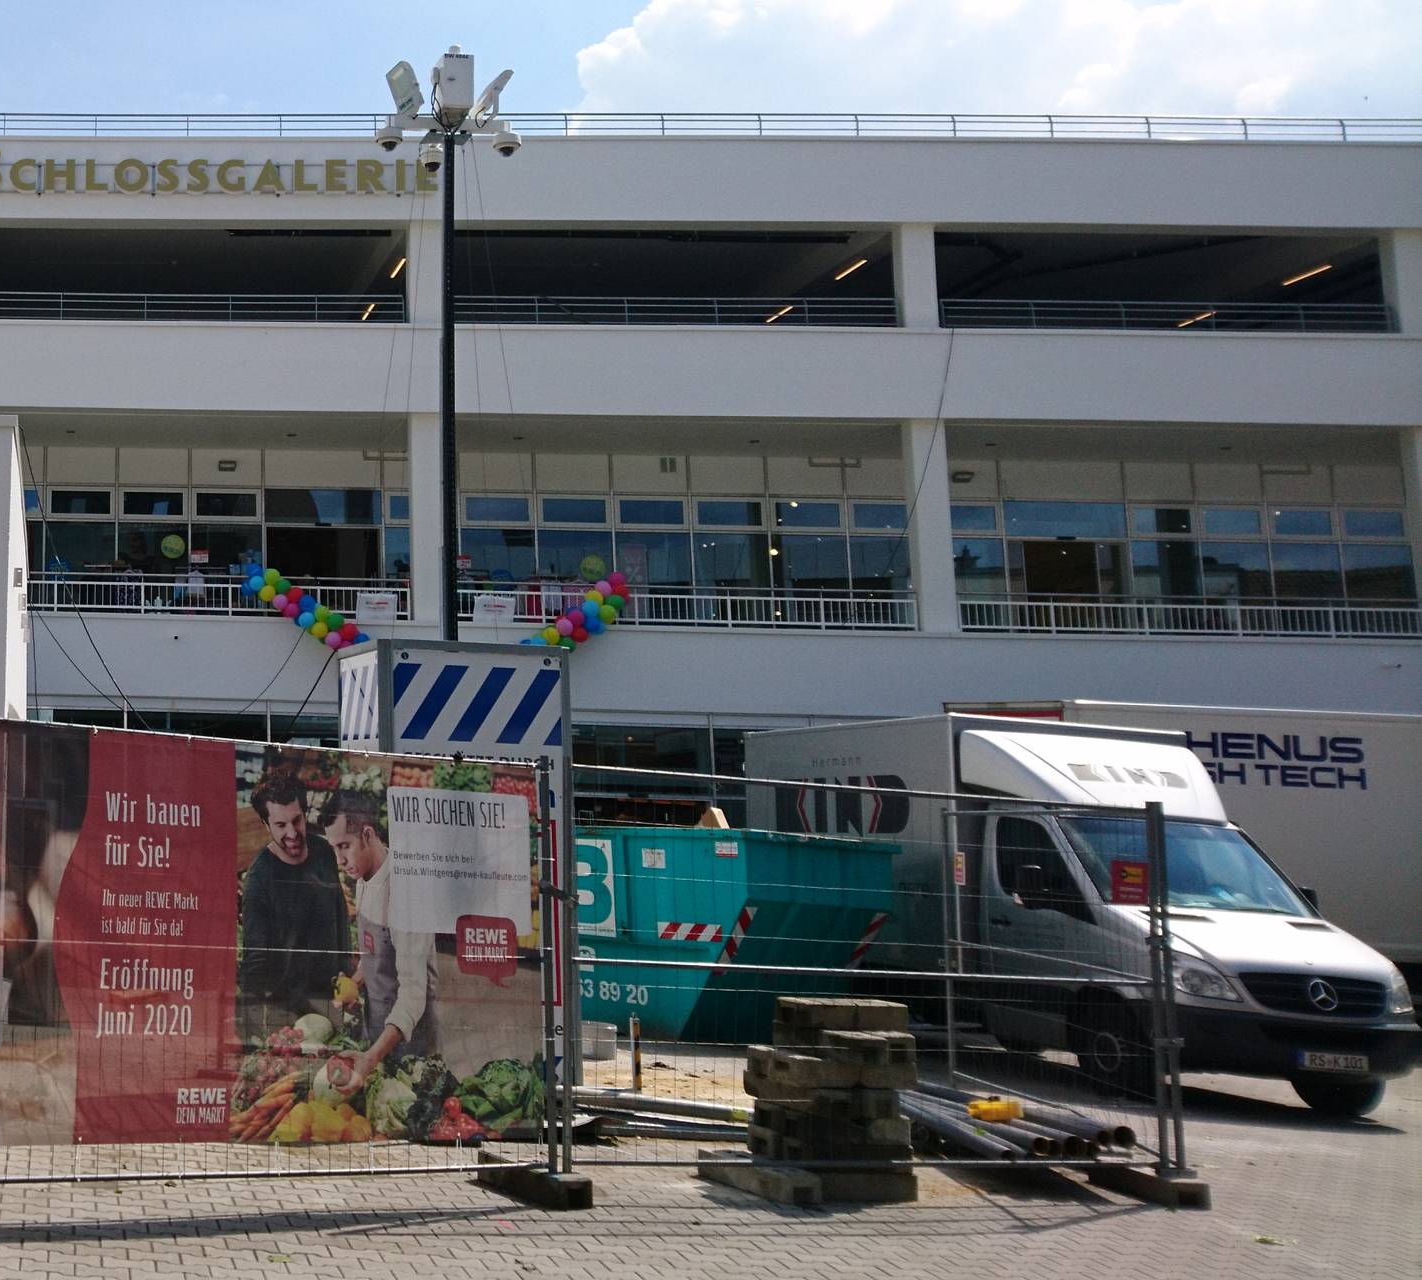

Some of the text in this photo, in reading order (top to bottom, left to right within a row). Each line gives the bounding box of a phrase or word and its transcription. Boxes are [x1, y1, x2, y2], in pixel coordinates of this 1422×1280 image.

[1186, 731, 1364, 763] HENUS
[1255, 764, 1369, 790] TECH
[105, 791, 201, 828] Wir bauen
[392, 794, 506, 829] WIR SUCHEN SIE!
[105, 834, 170, 868] für Sie!
[393, 850, 430, 861] Bewerben
[432, 852, 443, 862] Sie
[445, 853, 460, 863] sich
[102, 888, 199, 910] Ihr neuer REWE Markt
[101, 916, 184, 937] ist bald für Sie da!
[465, 927, 508, 945] REWE
[465, 945, 509, 963] DEIN MARKT
[99, 958, 194, 1000] Eröffnung
[599, 980, 620, 1002] 89
[625, 984, 648, 1006] 20
[96, 1003, 192, 1039] Juni 2020
[178, 1087, 227, 1105] REWE
[176, 1106, 226, 1125] DEIN MARKT
